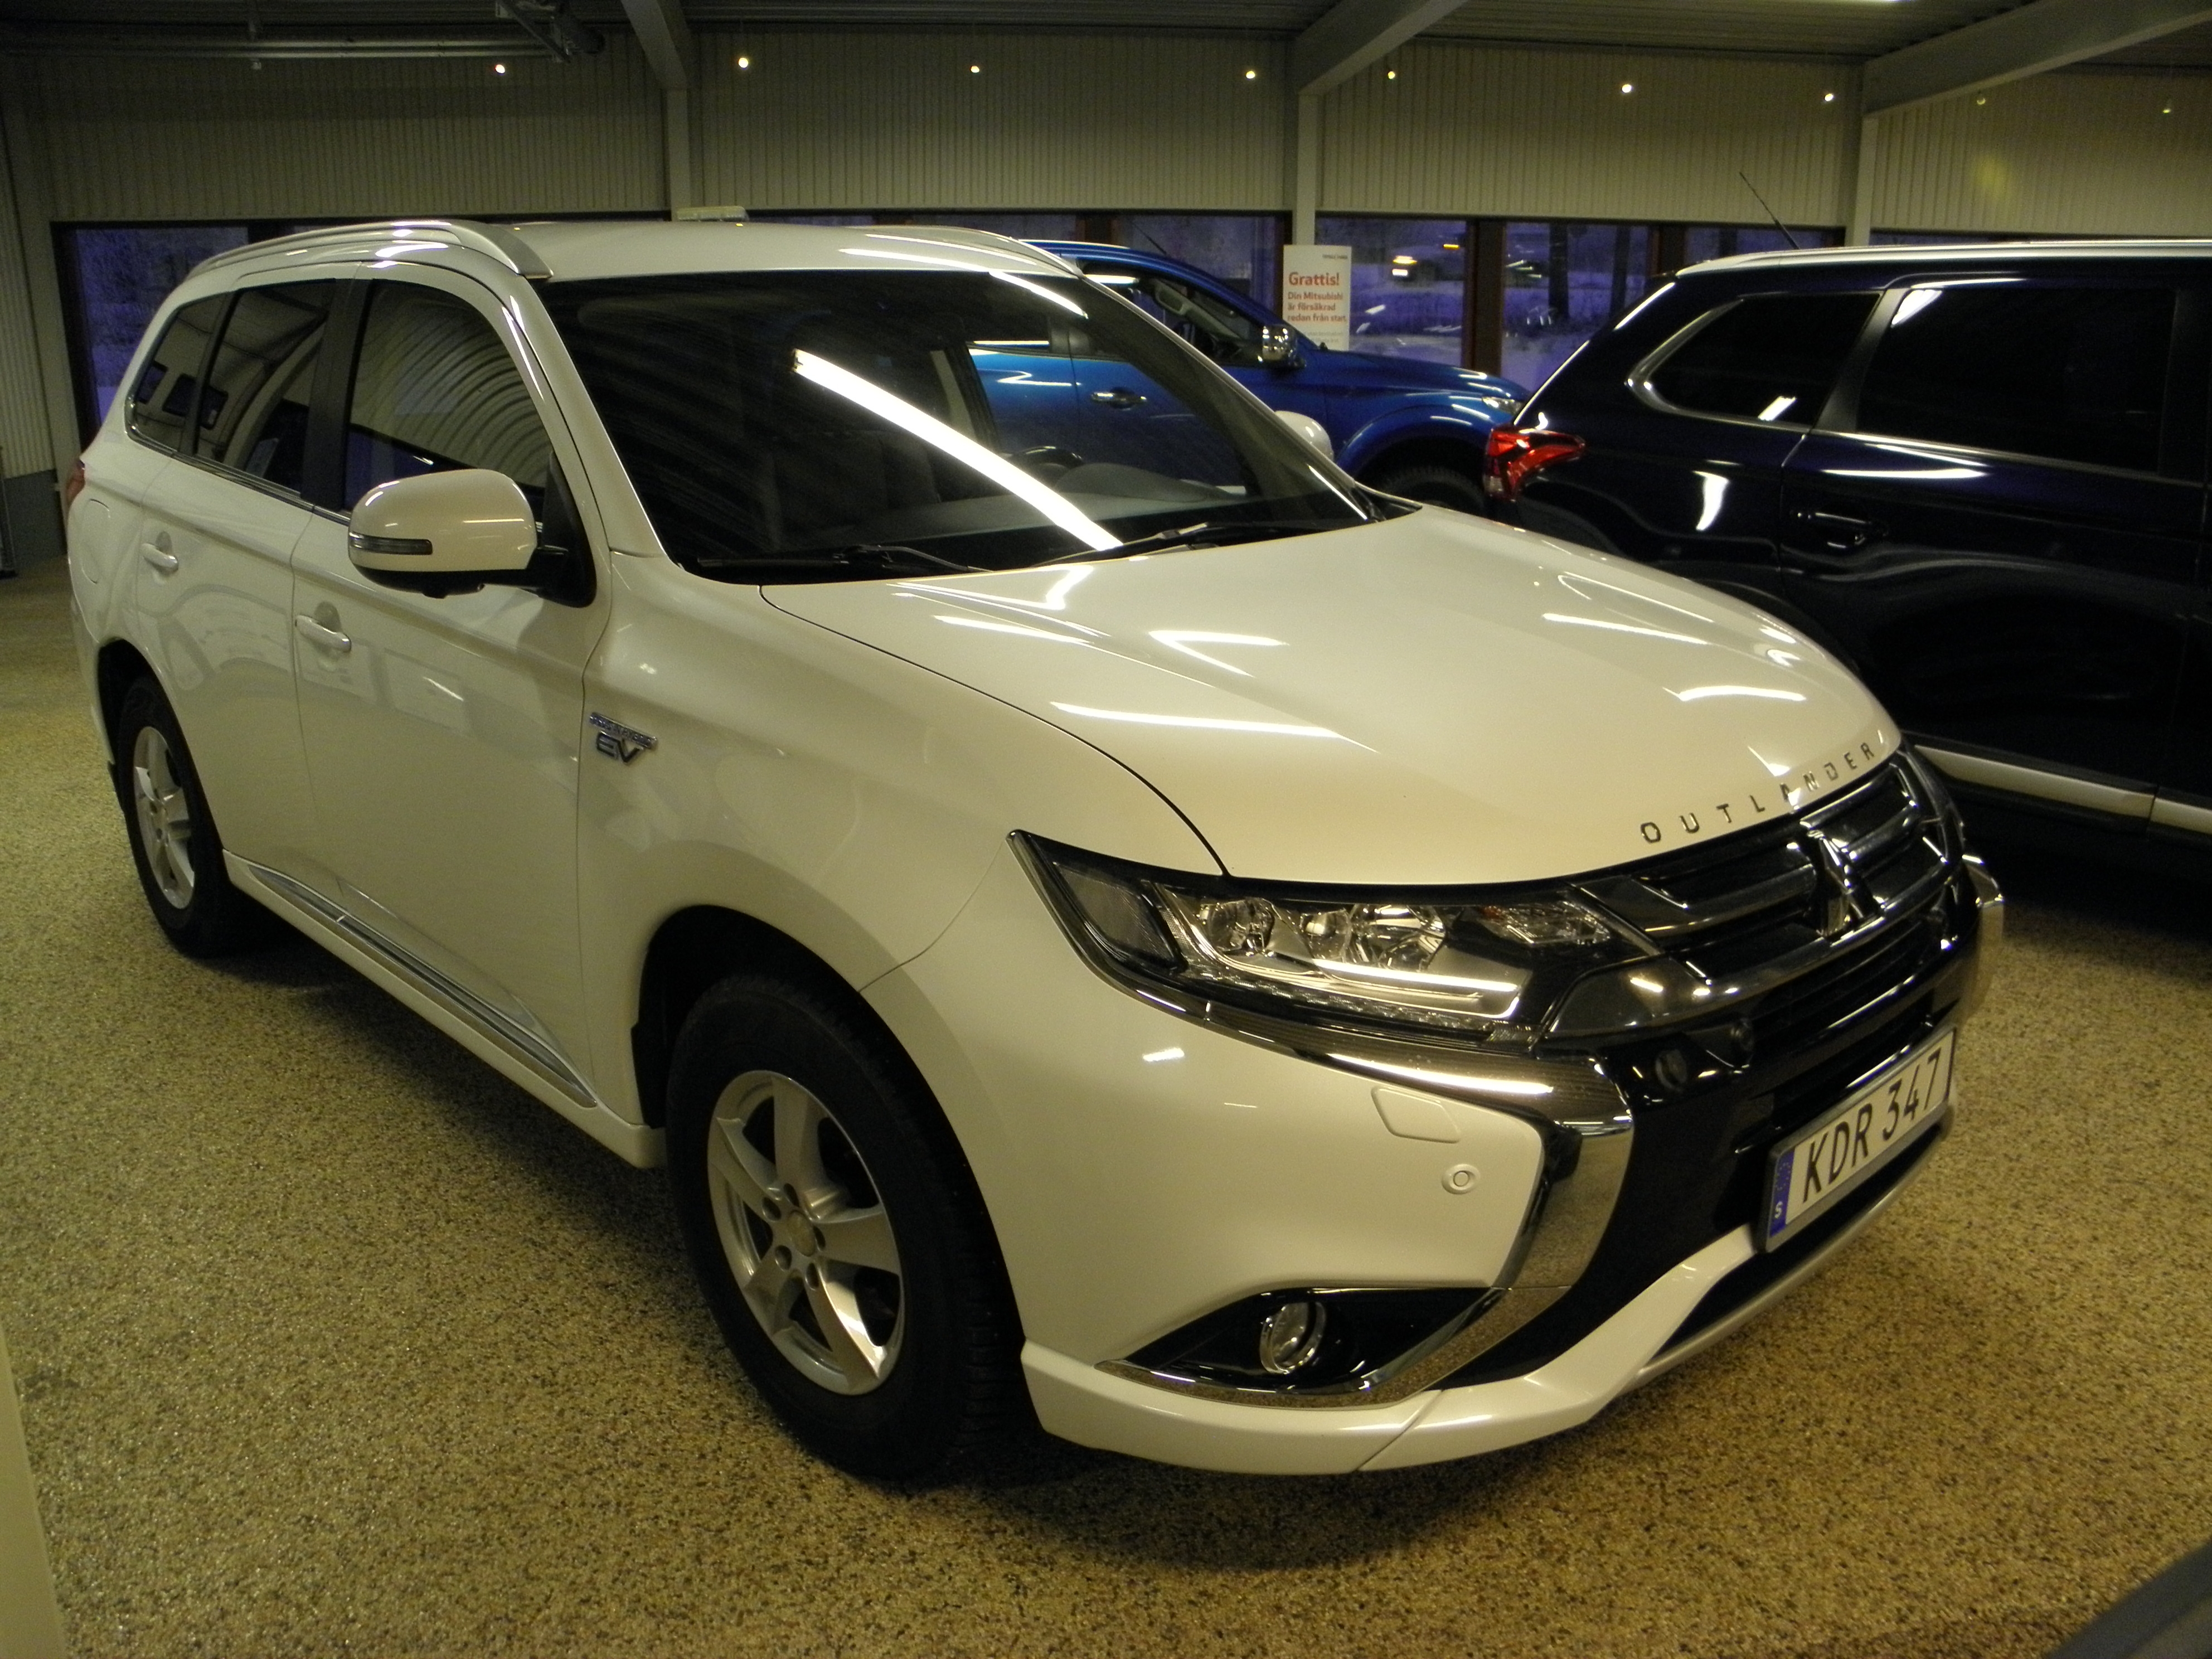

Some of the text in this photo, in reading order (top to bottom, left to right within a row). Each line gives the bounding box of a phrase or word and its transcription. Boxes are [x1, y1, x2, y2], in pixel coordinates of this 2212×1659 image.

[1288, 271, 1340, 286] Grattis!
[1288, 292, 1343, 300] Din Mitsubishi
[1288, 303, 1336, 311] är försäkrad
[596, 730, 641, 763] EV
[1639, 741, 1875, 844] OUTLANDER
[1802, 1047, 1942, 1204] KDR 347
[1774, 1201, 1783, 1219] S
